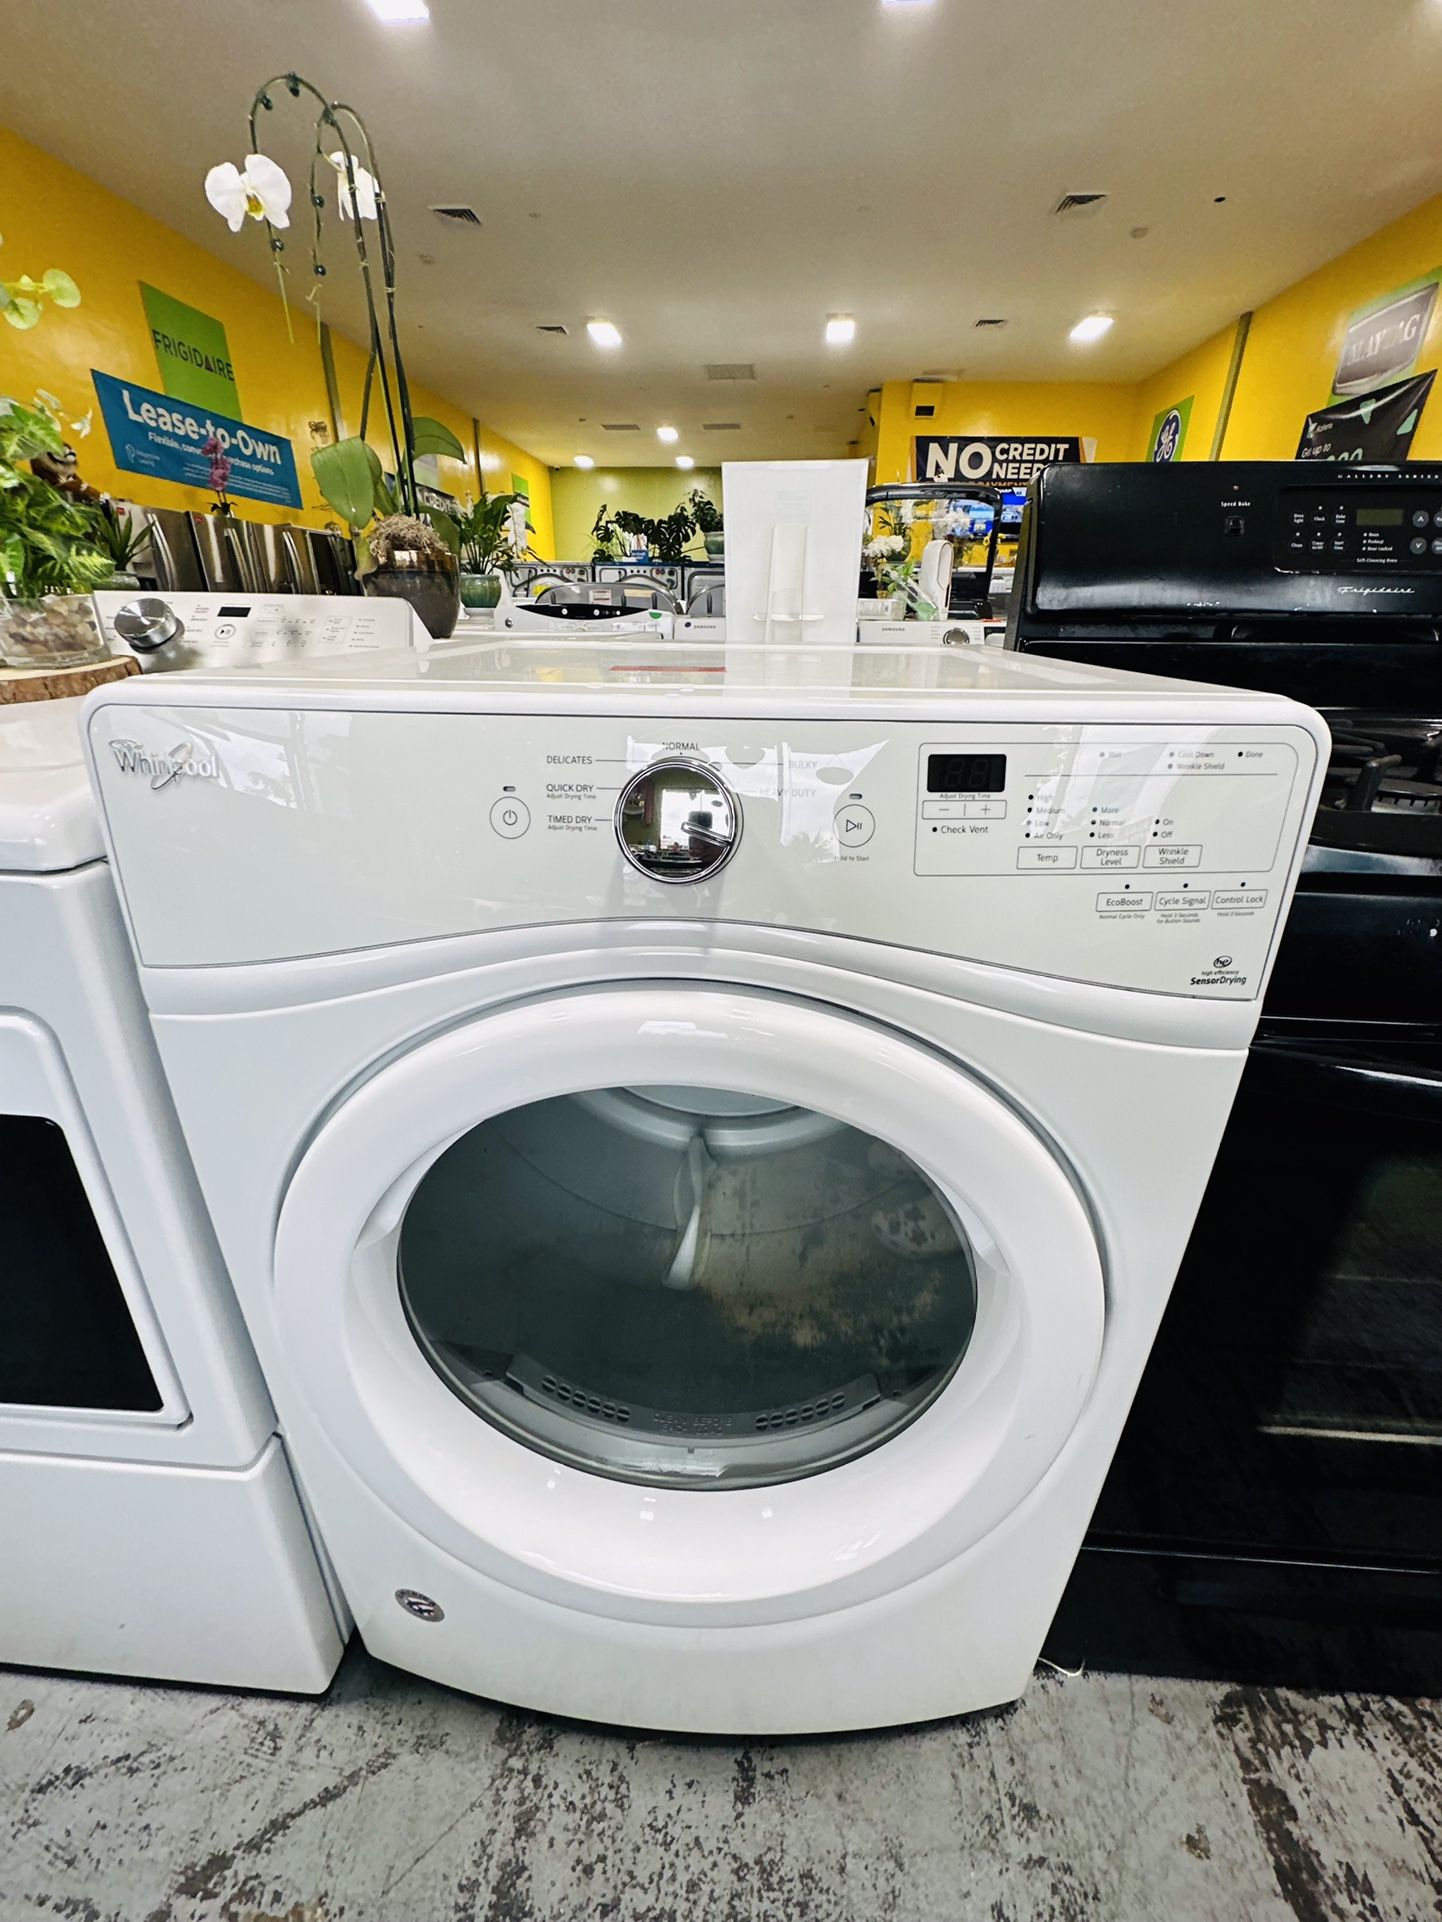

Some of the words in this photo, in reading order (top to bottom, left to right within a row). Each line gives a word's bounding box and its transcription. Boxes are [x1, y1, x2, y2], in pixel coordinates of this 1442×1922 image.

[152, 329, 235, 382] FRIGIDAIRE
[122, 389, 282, 465] Lease-to-Own
[926, 442, 993, 480] NO
[995, 443, 1069, 461] CREDIT
[1337, 586, 1415, 596] Frigidaire
[546, 755, 593, 765] DELICATES
[1195, 751, 1215, 759] Down
[788, 760, 818, 769] BULKY
[546, 783, 575, 792] QUICK
[575, 783, 594, 792] DRY
[791, 788, 817, 797] DUTY
[1100, 806, 1120, 814] More
[547, 815, 574, 824] TIMED
[575, 815, 593, 824] DRY
[1162, 819, 1174, 827] On
[940, 825, 967, 834] Check
[969, 825, 989, 834] Vent
[1033, 832, 1045, 840] Air
[1046, 831, 1064, 841] Only
[1098, 832, 1114, 840] Less
[1160, 831, 1174, 839] Off
[1096, 848, 1129, 858] Dryness
[1158, 847, 1189, 857] Wrinkle
[1036, 853, 1059, 864] Temp
[1100, 857, 1123, 866] Level
[1159, 856, 1186, 866] Shield
[1106, 898, 1144, 907] EcoBoost
[1158, 897, 1182, 907] Cycle
[1182, 896, 1207, 907] Signal
[1215, 895, 1244, 905] Control
[1245, 895, 1264, 904] Lock
[1190, 976, 1247, 986] SensorDrying
